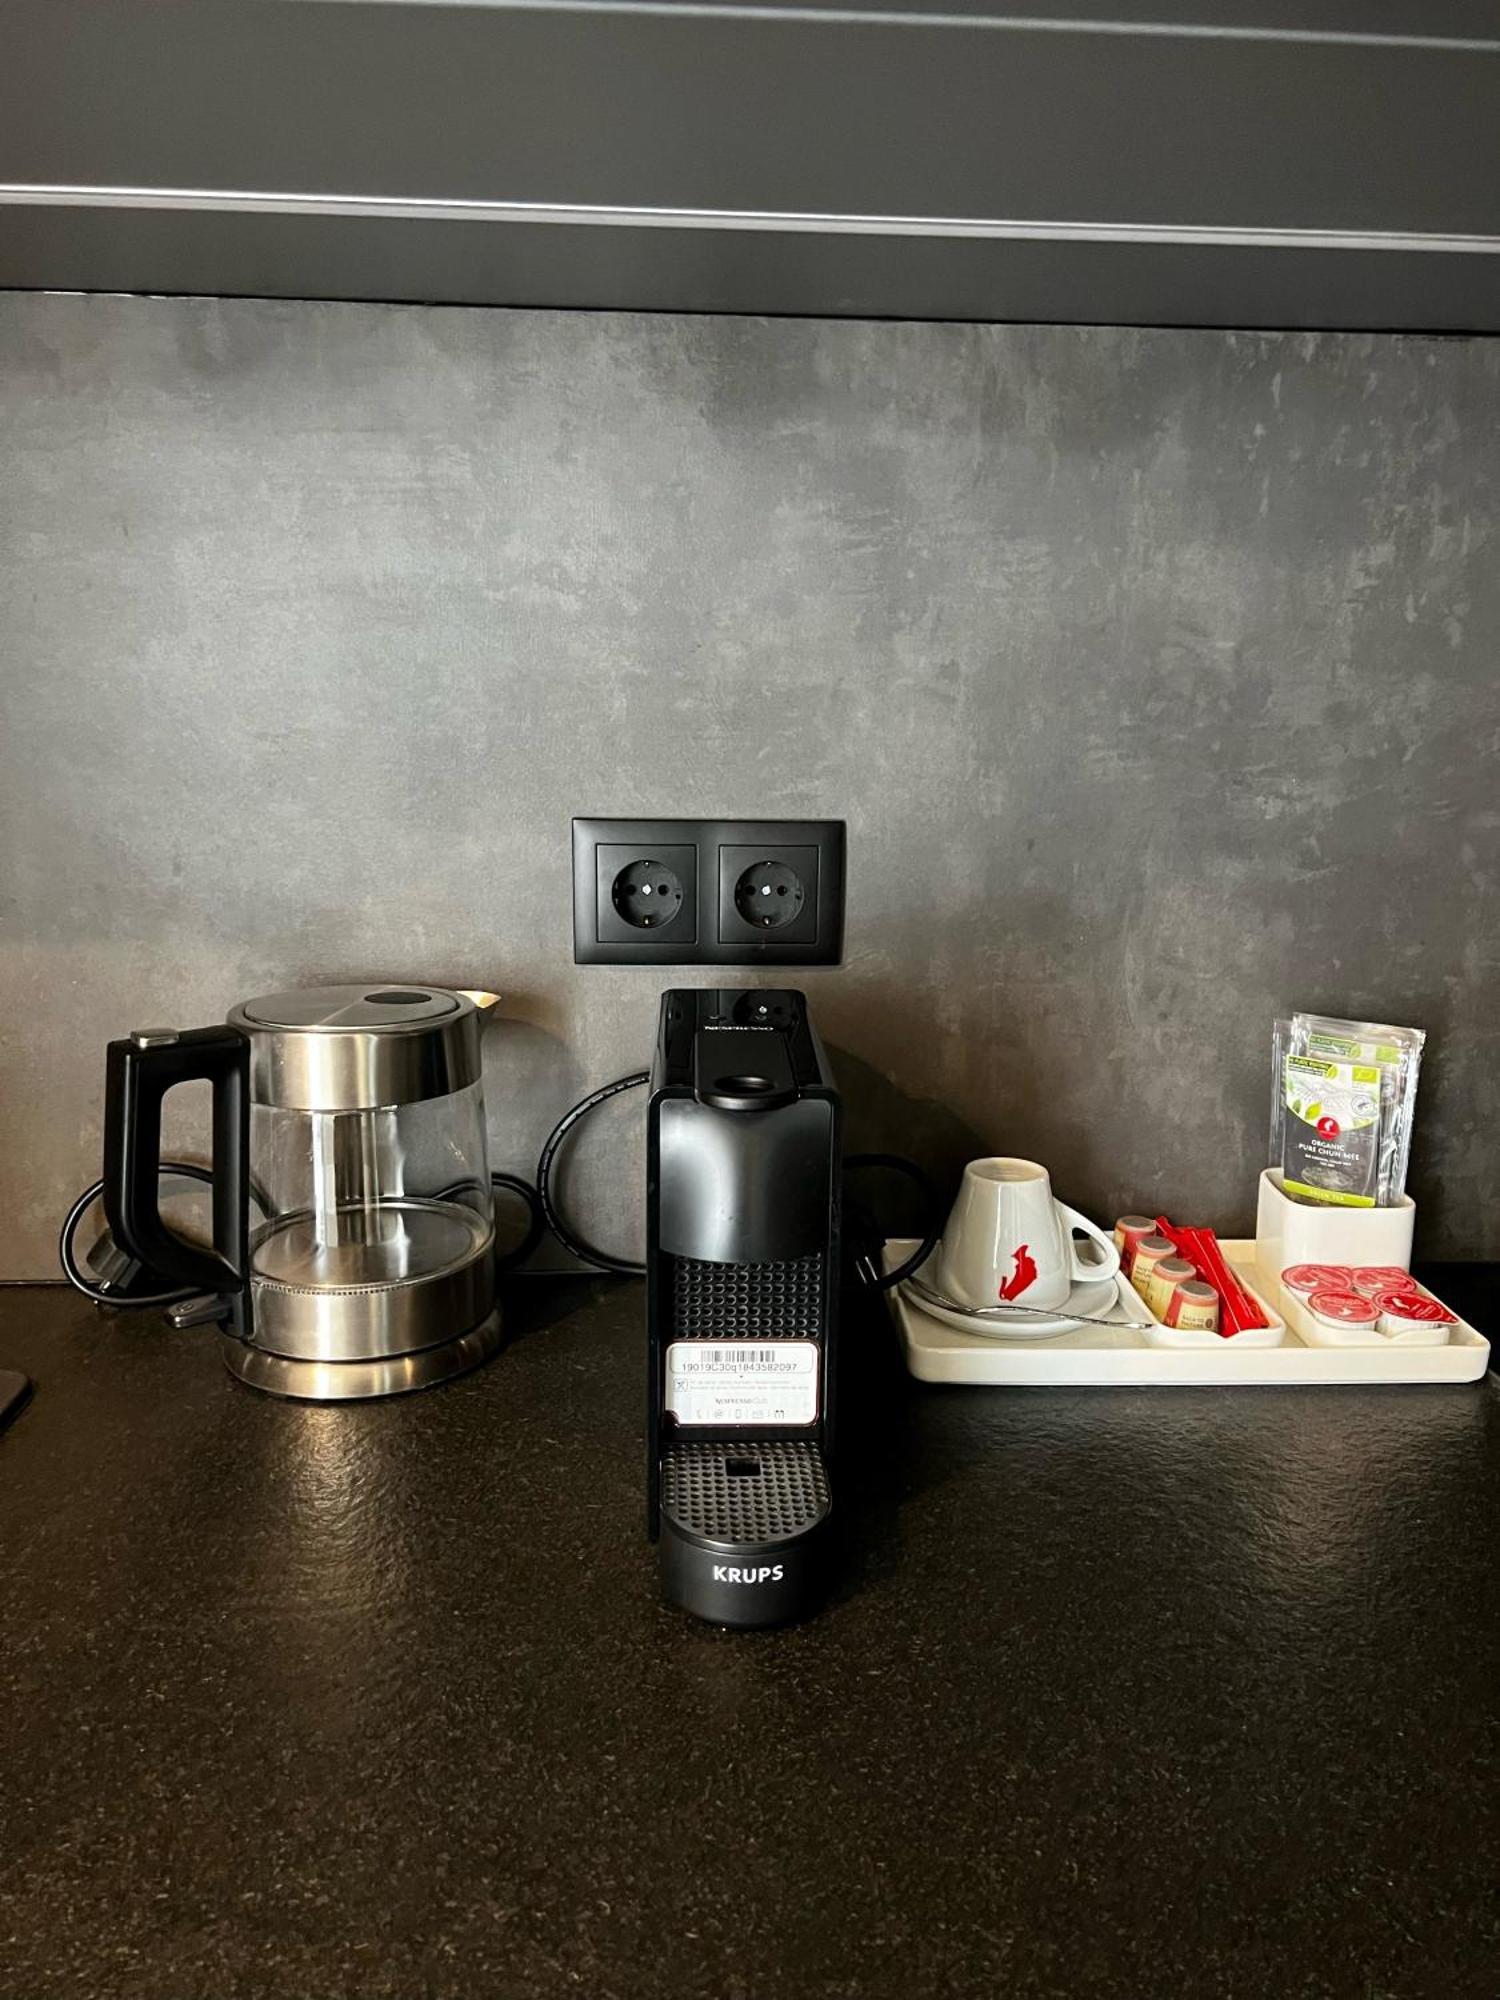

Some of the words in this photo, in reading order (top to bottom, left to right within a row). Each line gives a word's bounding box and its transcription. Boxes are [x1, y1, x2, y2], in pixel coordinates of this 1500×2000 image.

[1298, 1143, 1317, 1153] PURE
[1311, 1139, 1345, 1152] ORGANIC
[713, 1565, 784, 1584] KRUPS
